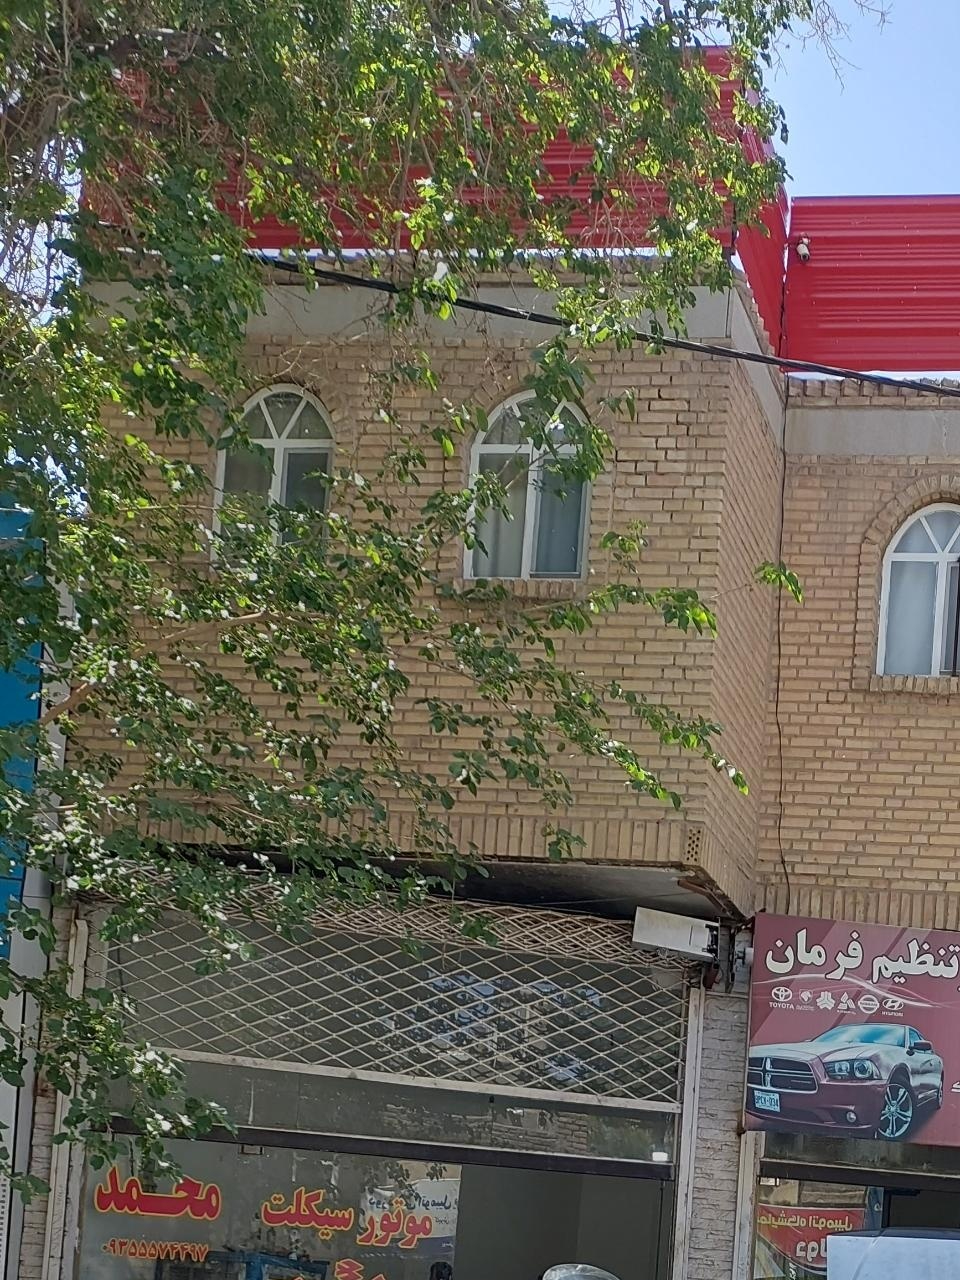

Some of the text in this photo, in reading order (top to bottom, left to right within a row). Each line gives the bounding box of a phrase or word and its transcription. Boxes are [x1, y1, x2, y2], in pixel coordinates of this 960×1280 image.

[764, 928, 865, 980] فرمان
[769, 1001, 795, 1011] TOYOTA
[94, 1166, 223, 1221] محمد
[260, 1186, 433, 1249] موتور سیکلت
